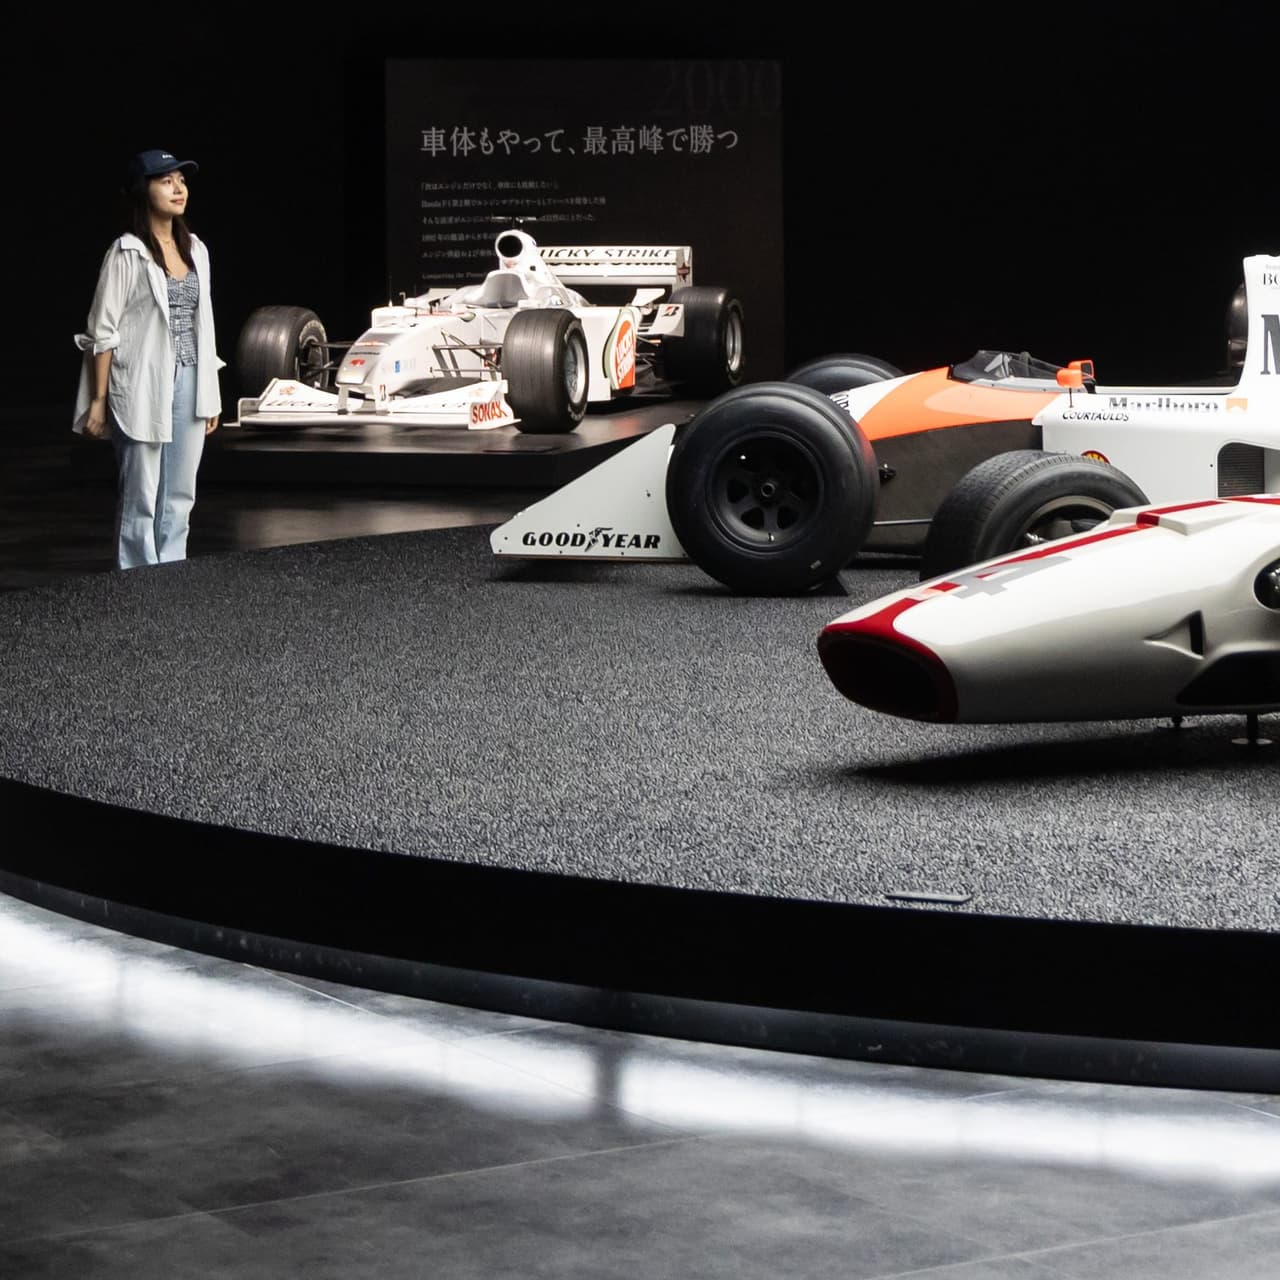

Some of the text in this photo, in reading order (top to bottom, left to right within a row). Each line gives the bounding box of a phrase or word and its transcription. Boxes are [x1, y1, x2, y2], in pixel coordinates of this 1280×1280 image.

[419, 125, 739, 158] 車体もやって、最高峰で勝つ
[539, 248, 595, 258] UCKY
[471, 400, 508, 424] SONAX
[1062, 411, 1130, 422] COURTAULDS
